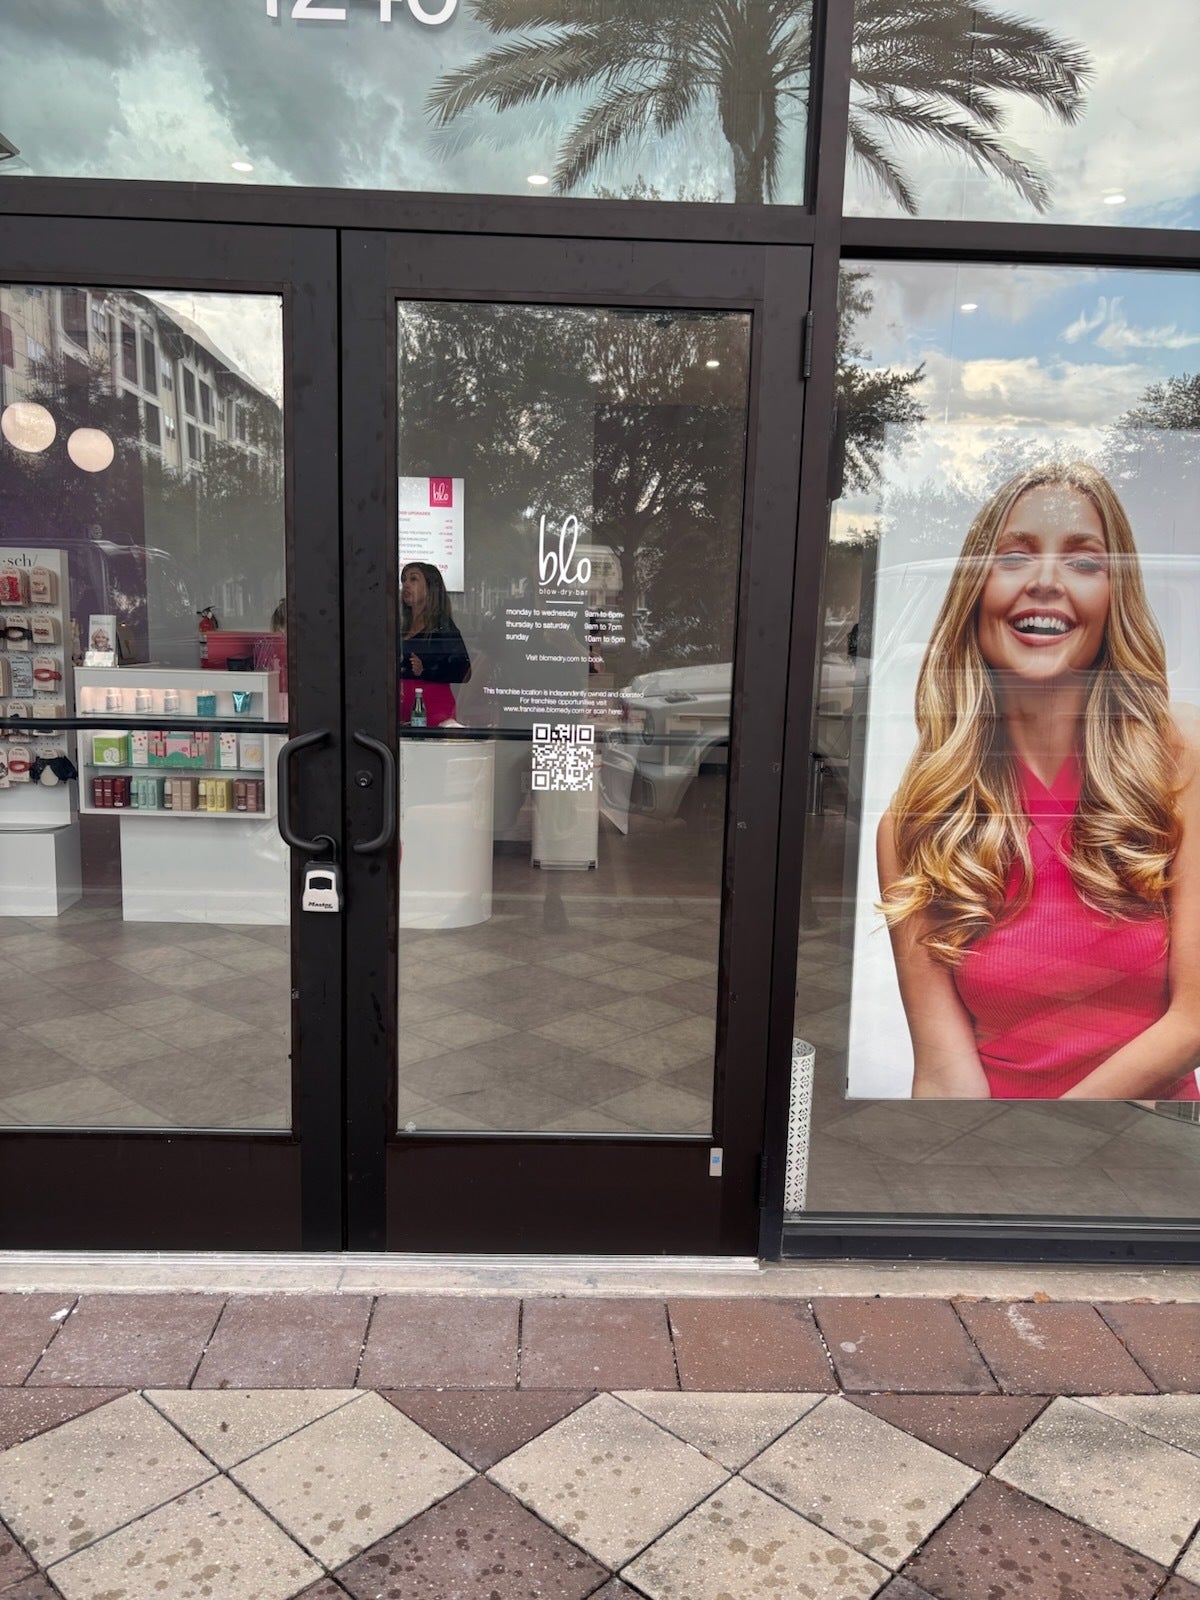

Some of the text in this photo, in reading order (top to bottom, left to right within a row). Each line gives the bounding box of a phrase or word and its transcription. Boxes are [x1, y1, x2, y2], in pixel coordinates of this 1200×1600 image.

[539, 514, 591, 586] blo
[506, 608, 532, 617] monday
[542, 608, 578, 618] wednesday
[506, 621, 534, 630] thursday
[543, 622, 570, 630] saturday
[608, 623, 622, 632] 7pm
[506, 633, 529, 642] sunday
